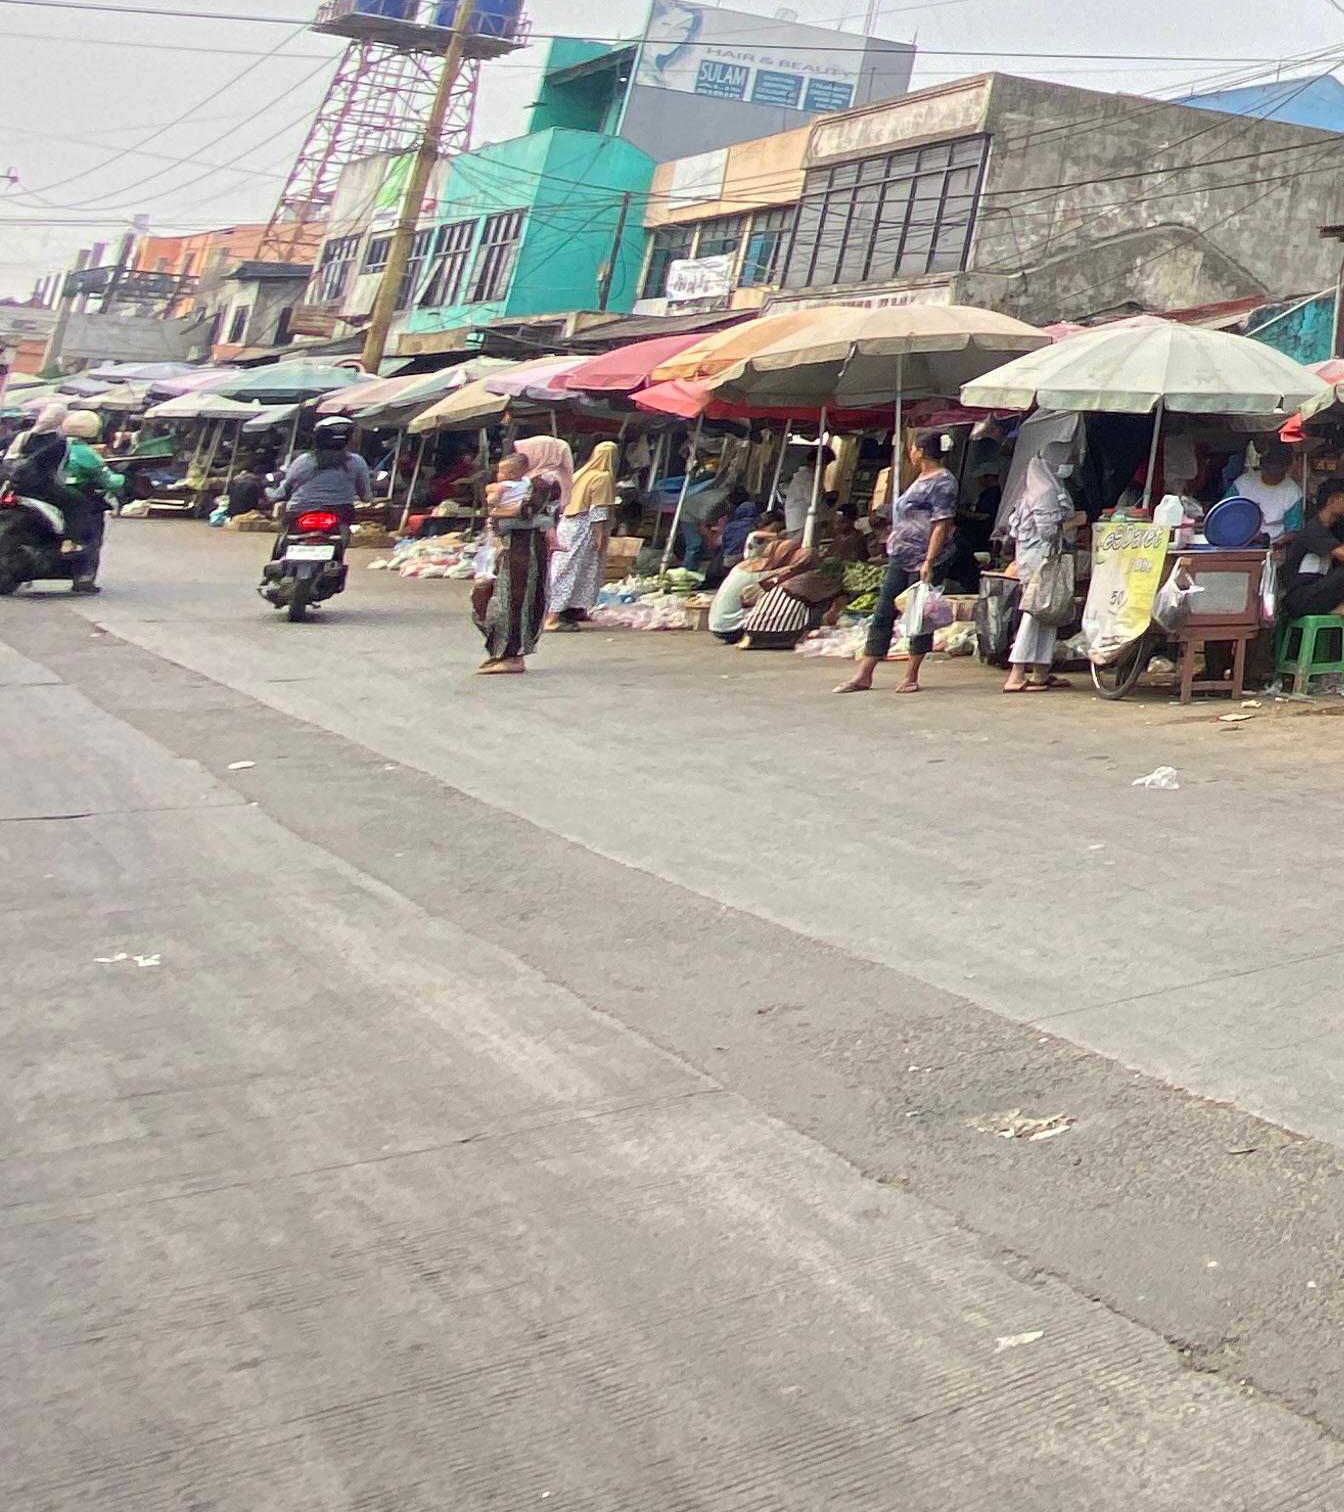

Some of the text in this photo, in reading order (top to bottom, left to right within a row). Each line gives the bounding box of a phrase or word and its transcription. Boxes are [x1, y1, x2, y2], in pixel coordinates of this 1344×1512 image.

[699, 61, 747, 86] SULAM
[706, 47, 852, 78] HAIR & BEAUTY
